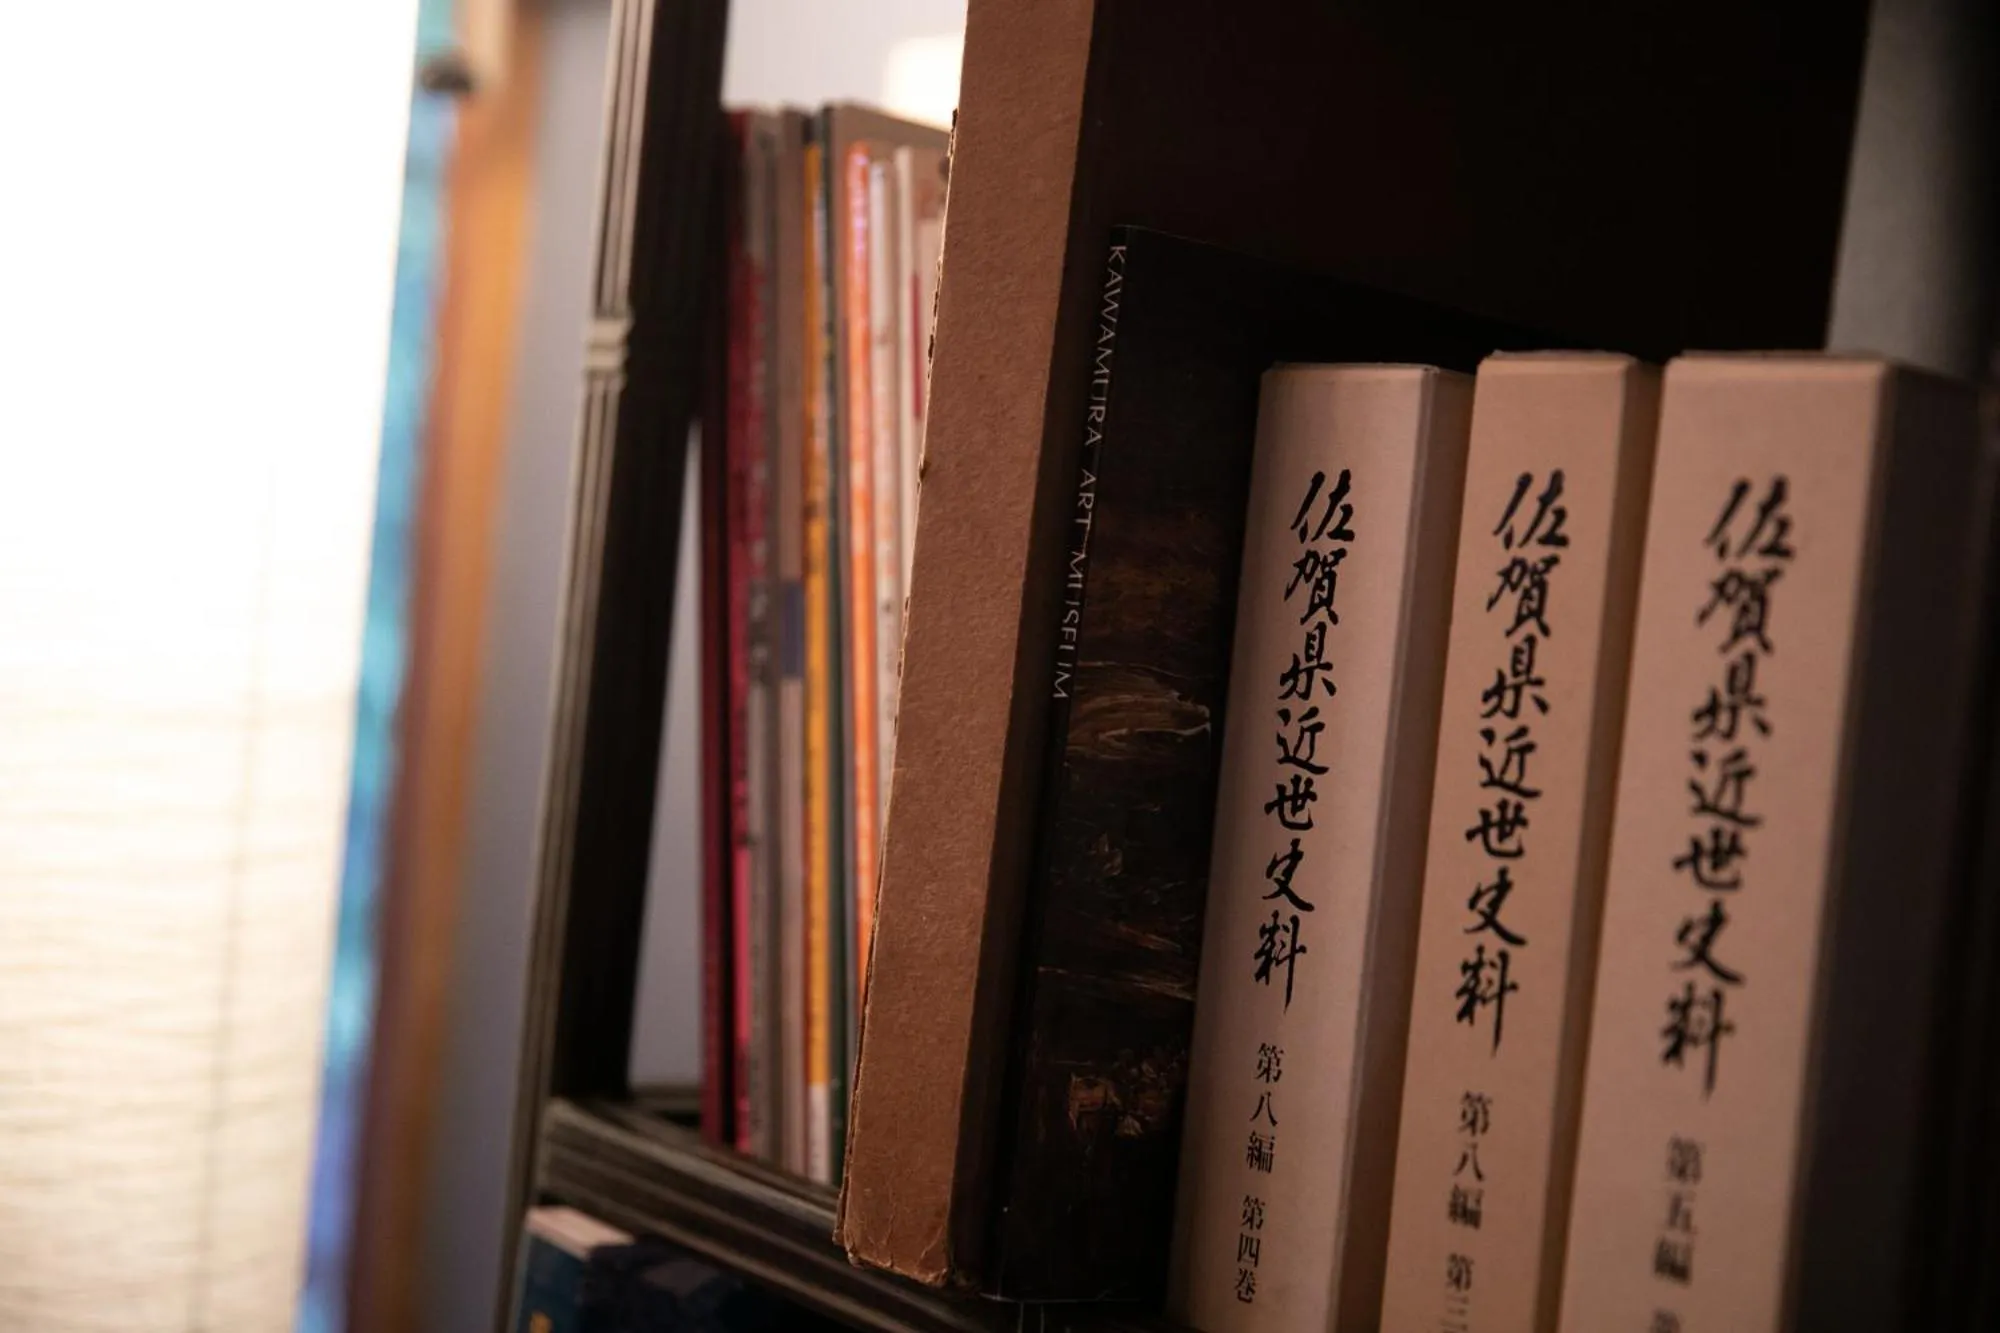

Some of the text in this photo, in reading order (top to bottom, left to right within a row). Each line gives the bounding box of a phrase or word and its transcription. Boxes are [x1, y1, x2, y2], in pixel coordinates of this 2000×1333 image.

[1052, 245, 1128, 699] KAWAMURA ART MUSEUM
[1455, 469, 1571, 1058] 佐賀県近世史料
[1233, 469, 1356, 1305] 佐賀県近世史料 第八編 第四巻
[1660, 475, 1796, 1098] 佐賀県近世史料
[1447, 1090, 1493, 1232] 第八編
